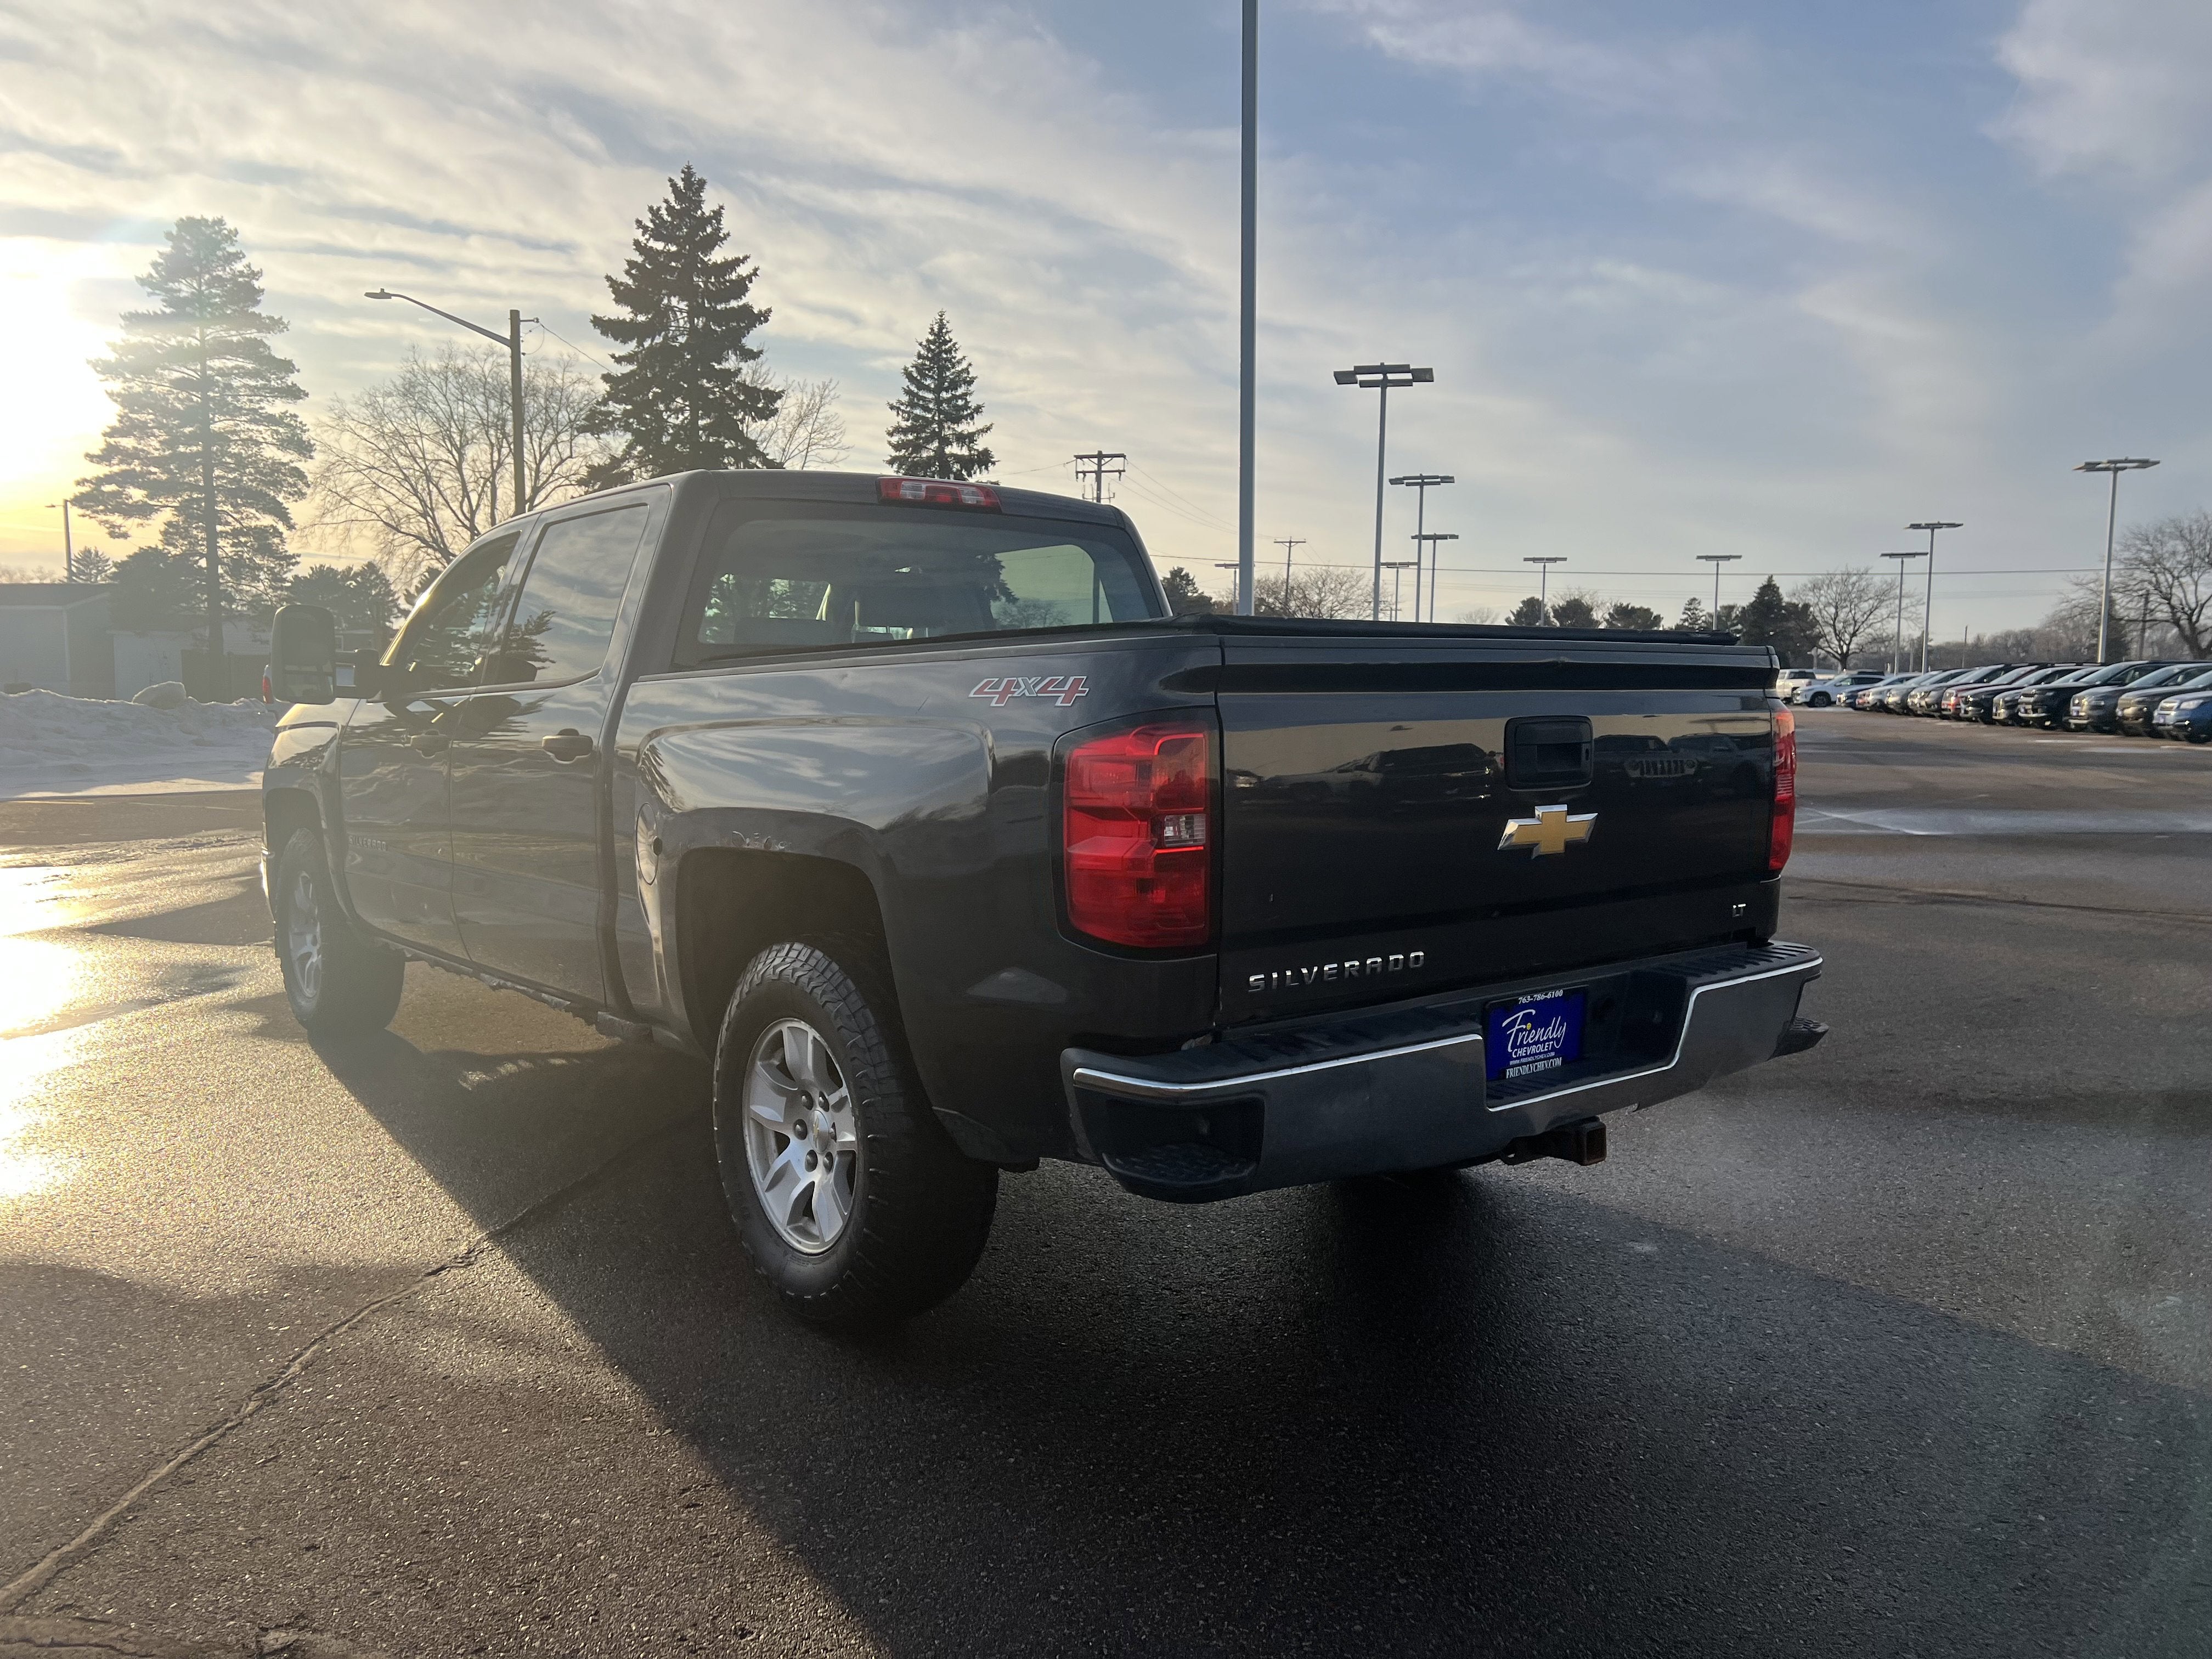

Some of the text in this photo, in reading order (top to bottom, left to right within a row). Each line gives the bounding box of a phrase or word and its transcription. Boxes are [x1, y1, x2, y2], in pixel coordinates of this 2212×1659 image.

[1733, 904, 1746, 917] LT
[1248, 951, 1425, 992] SILVERADO
[1519, 990, 1563, 1004] 763-786-6100
[1502, 1009, 1566, 1052] Friendly
[1512, 1041, 1553, 1058] CHEVROLET
[1506, 1057, 1562, 1079] FRIENDLYCHEV.COM
